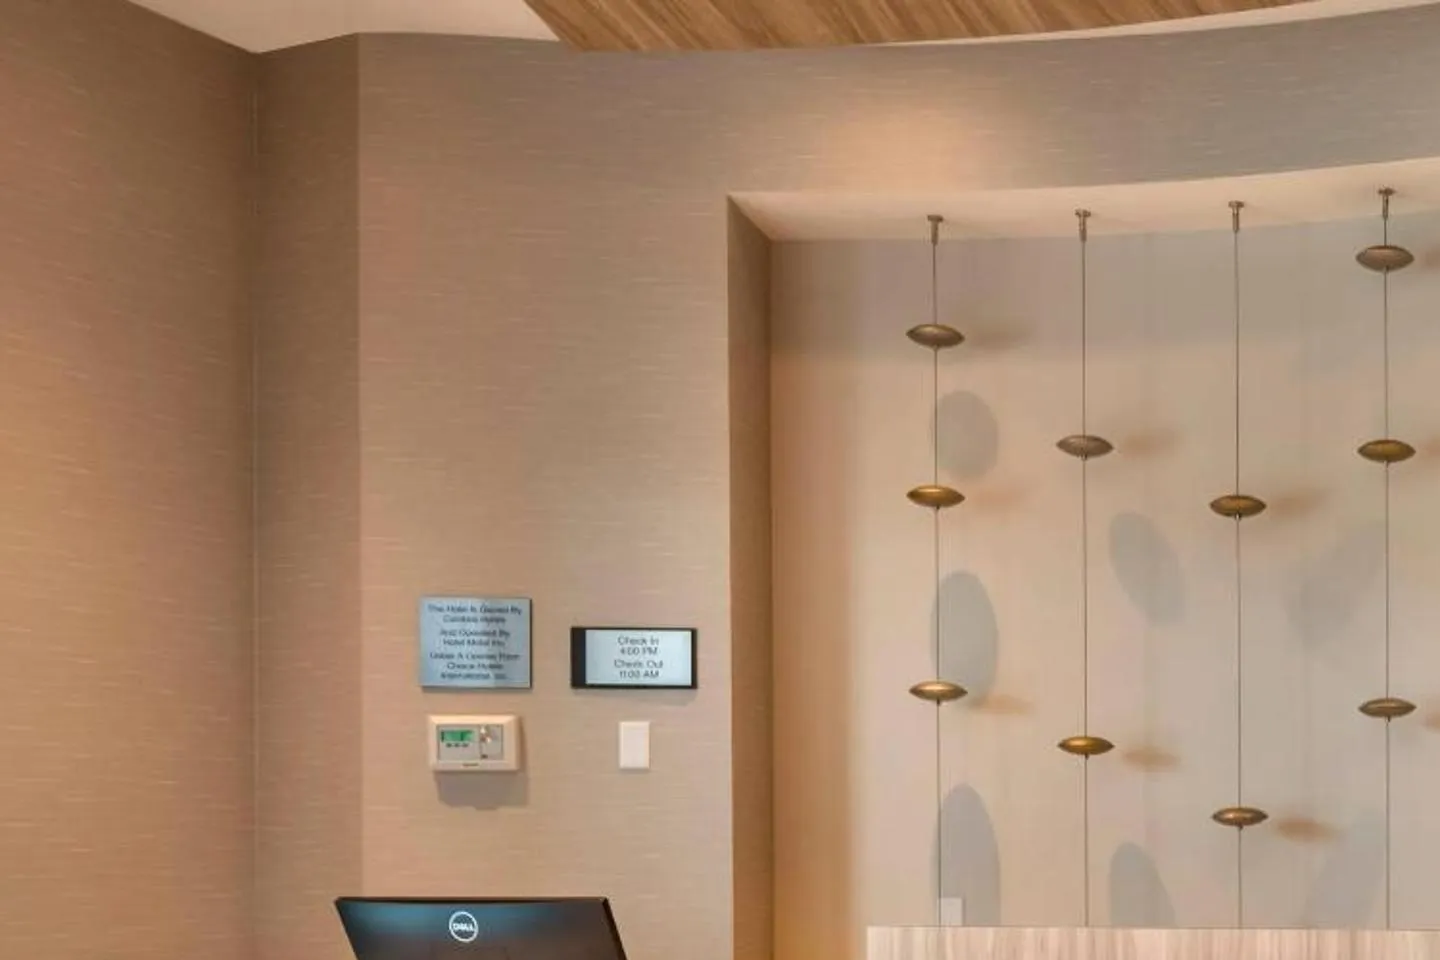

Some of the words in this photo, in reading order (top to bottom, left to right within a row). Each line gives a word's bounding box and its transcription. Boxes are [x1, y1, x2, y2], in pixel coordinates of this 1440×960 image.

[618, 636, 648, 646] Check
[650, 636, 660, 646] In
[642, 647, 658, 656] PM
[614, 660, 643, 668] Check
[646, 660, 664, 668] Out
[644, 670, 660, 678] AM
